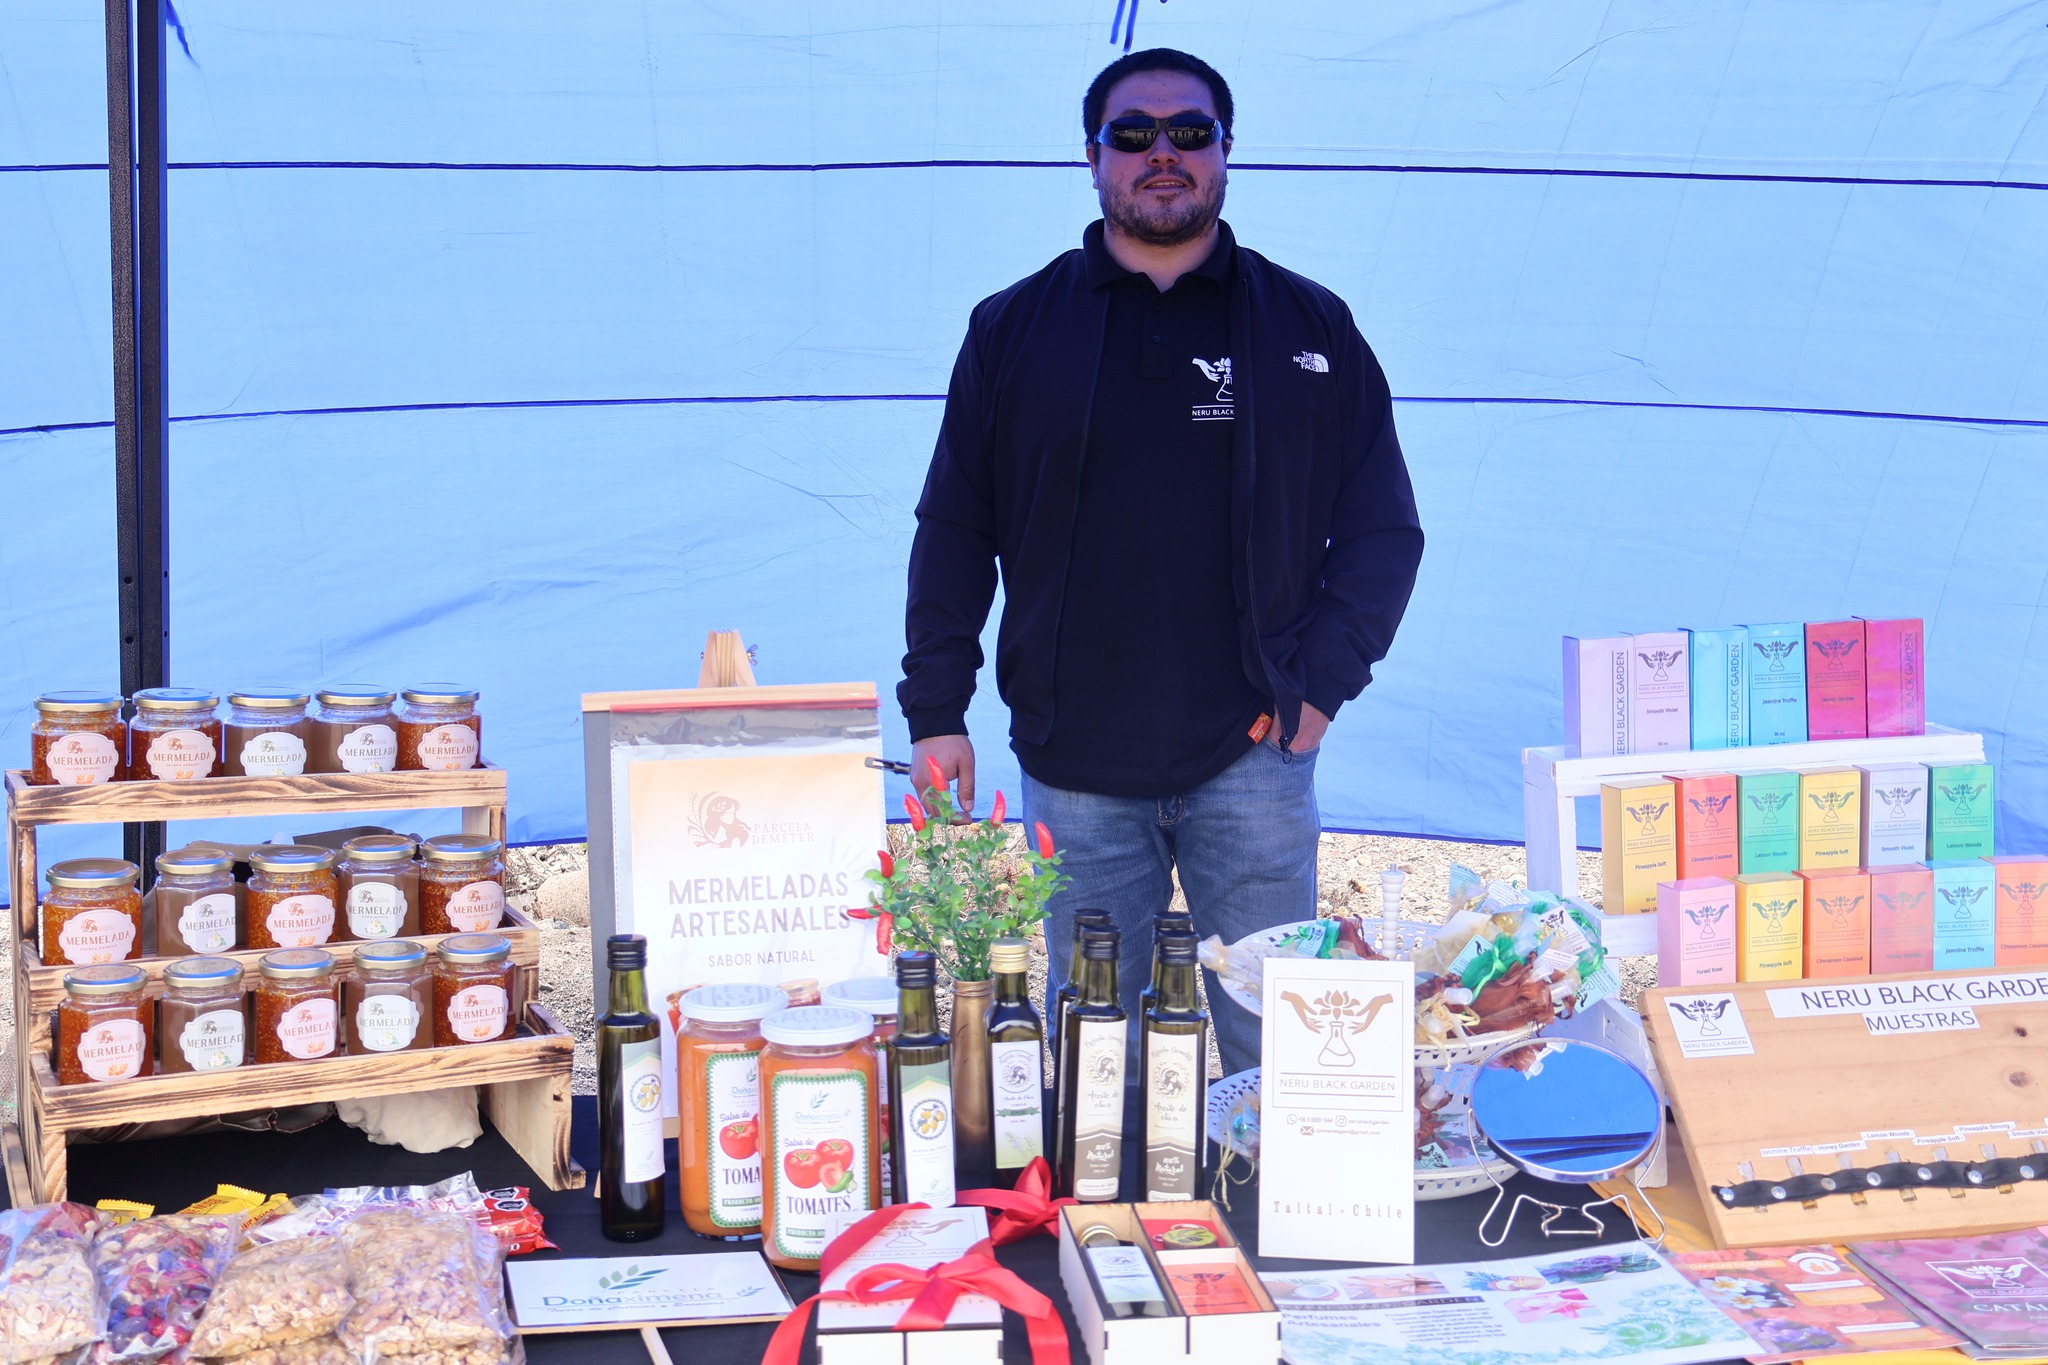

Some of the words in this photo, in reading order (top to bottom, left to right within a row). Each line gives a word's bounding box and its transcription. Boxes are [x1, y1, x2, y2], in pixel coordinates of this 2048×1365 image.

[1292, 355, 1315, 365] NORTH
[1301, 350, 1314, 358] THE
[1301, 363, 1316, 371] FACE
[1905, 633, 1913, 675] GARDEN
[1731, 644, 1739, 687] GARDEN
[1616, 651, 1625, 694] GARDEN
[1905, 678, 1914, 709] BLACK
[1731, 688, 1739, 720] BLACK
[1616, 696, 1626, 729] BLACK
[345, 745, 396, 757] MERMELADA
[424, 744, 476, 755] MERMELADA
[53, 755, 114, 766] MERMELADA
[153, 751, 212, 762] MERMELADA
[247, 752, 302, 763] MERMELADA
[753, 822, 812, 833] PARCELA
[751, 831, 815, 845] DEMETER
[1635, 862, 1657, 870] Pineapple
[668, 871, 849, 905] MERMELADAS
[273, 914, 332, 929] MERMELADA
[670, 904, 850, 939] ARTESANALES
[66, 930, 131, 946] MERMELADA
[708, 952, 752, 967] SABOR
[757, 949, 816, 966] NATURAL
[1800, 987, 1872, 1010] NERU
[1878, 982, 1962, 1005] BLACK
[1865, 1010, 1976, 1032] MUESTRAS
[1279, 1078, 1309, 1088] NERU
[1312, 1079, 1347, 1089] BLACK
[1350, 1080, 1395, 1091] GARDEN
[1087, 1089, 1109, 1101] Aceite
[1152, 1102, 1175, 1113] Aceite
[1178, 1104, 1187, 1113] de
[719, 1112, 740, 1123] Salsa
[740, 1110, 751, 1119] de
[783, 1137, 803, 1148] Salsa
[805, 1137, 815, 1146] de
[1095, 1142, 1112, 1151] 100%
[1838, 1141, 1861, 1149] Garden
[1086, 1149, 1115, 1161] Natural
[1762, 1148, 1788, 1156] Jasmine
[1162, 1156, 1180, 1164] 100%
[1155, 1161, 1184, 1174] Natural
[722, 1166, 761, 1186] TOMA
[786, 1195, 851, 1216] TOMATES
[1273, 1200, 1333, 1215] Taltal
[1352, 1204, 1402, 1218] Chile
[543, 1290, 723, 1307] Doñaximena
[1282, 1312, 1358, 1321] Perfumes
[1287, 1320, 1382, 1328] Artesanales
